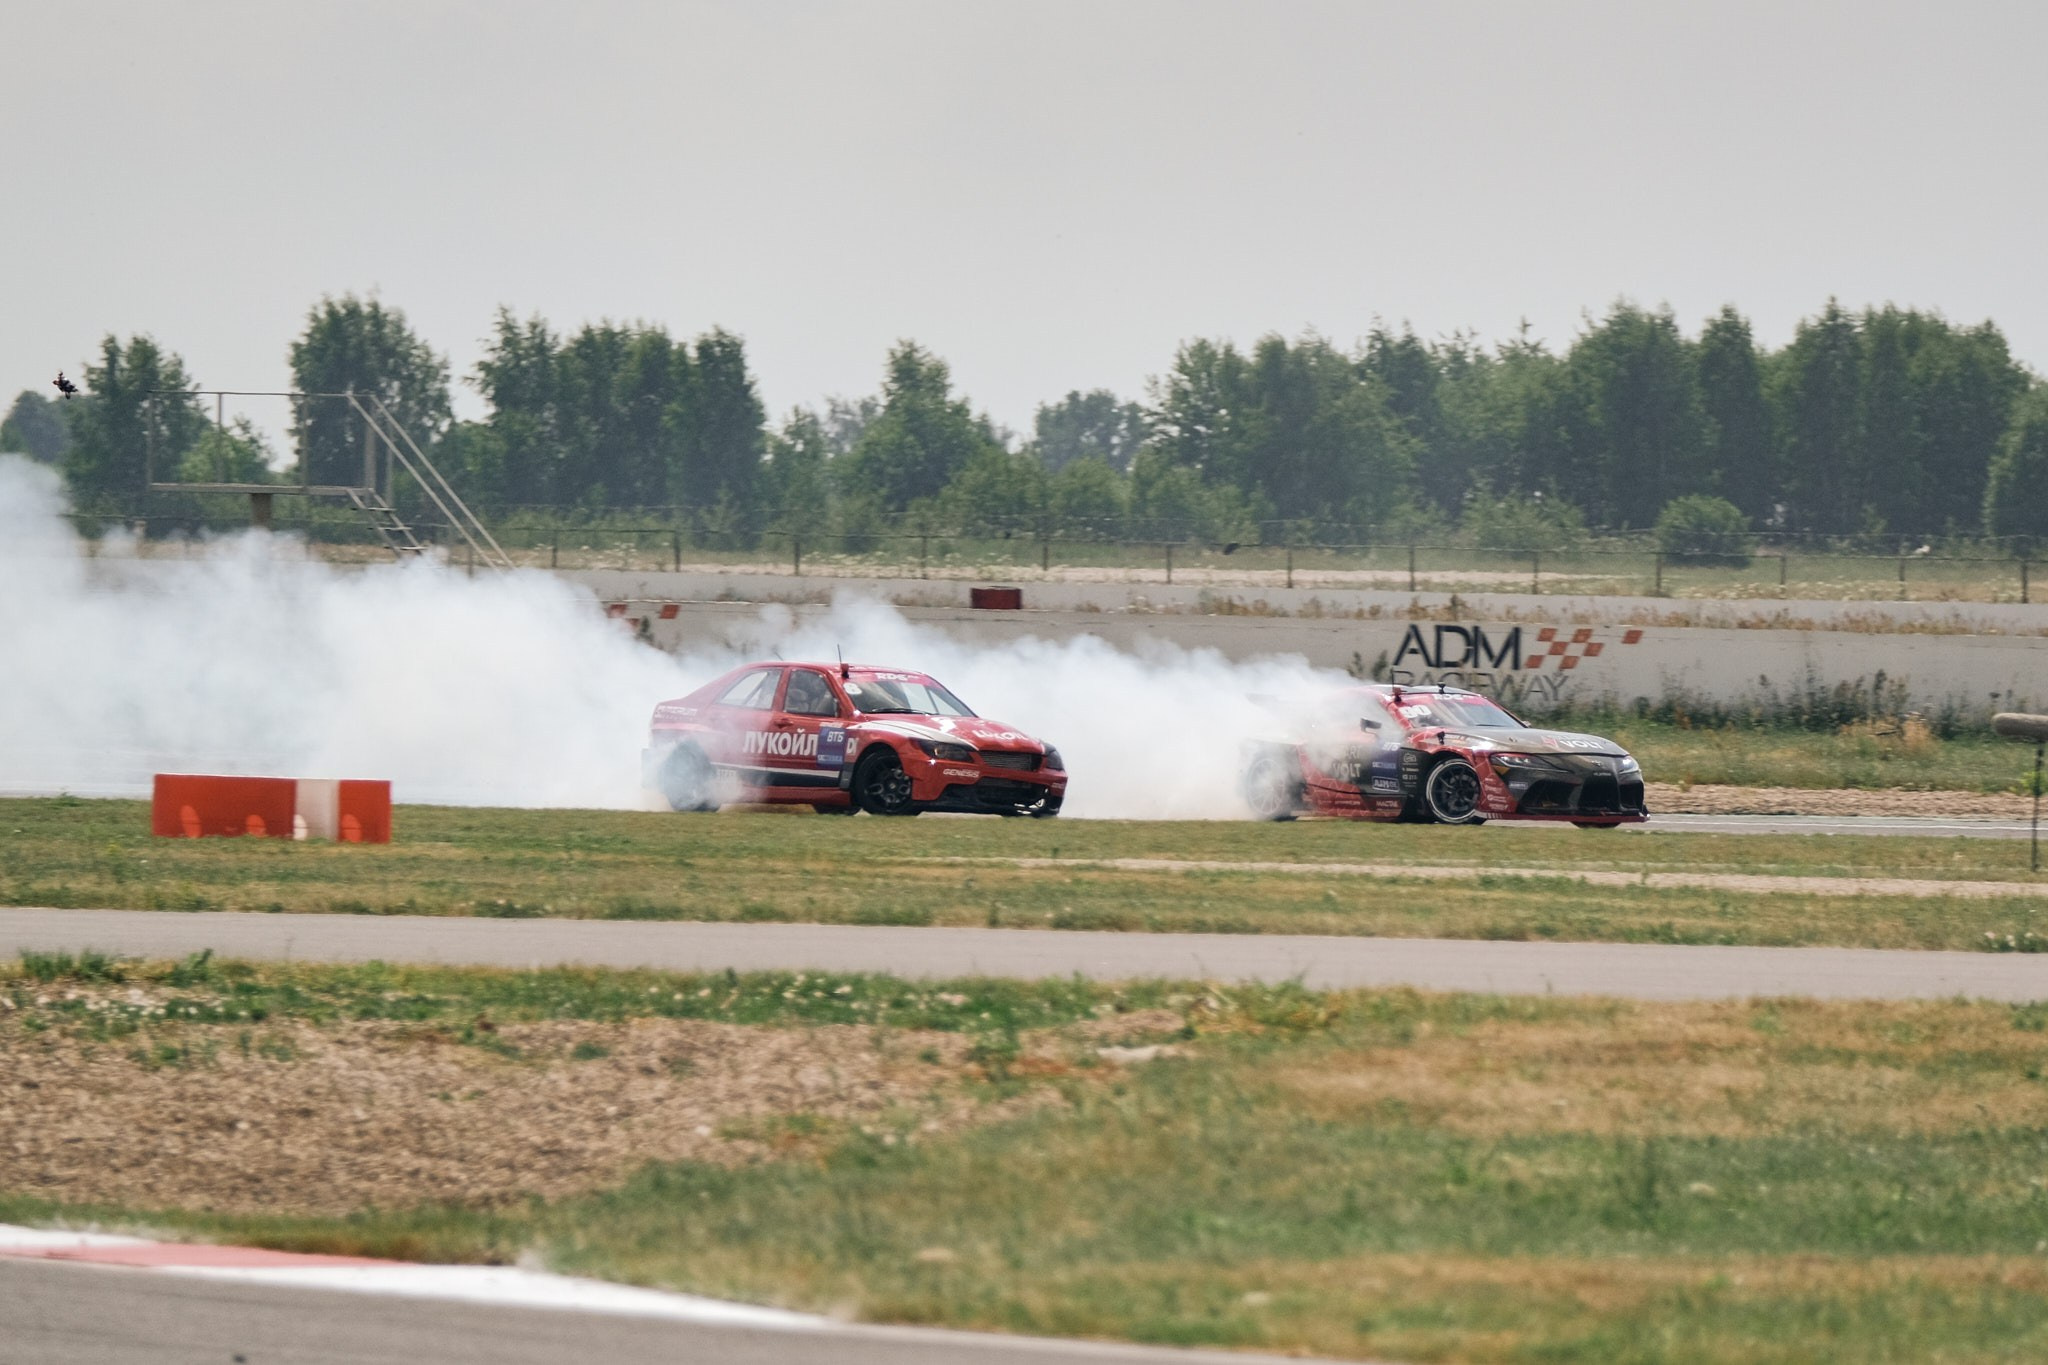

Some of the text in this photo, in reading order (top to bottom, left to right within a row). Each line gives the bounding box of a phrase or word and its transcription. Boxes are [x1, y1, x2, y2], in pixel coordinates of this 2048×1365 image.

[1394, 624, 1522, 670] ADM
[743, 728, 818, 756] ЛУКОЙЛ
[827, 731, 845, 743] ВТБ
[1560, 740, 1604, 749] VOLT
[1331, 762, 1361, 778] VOLT
